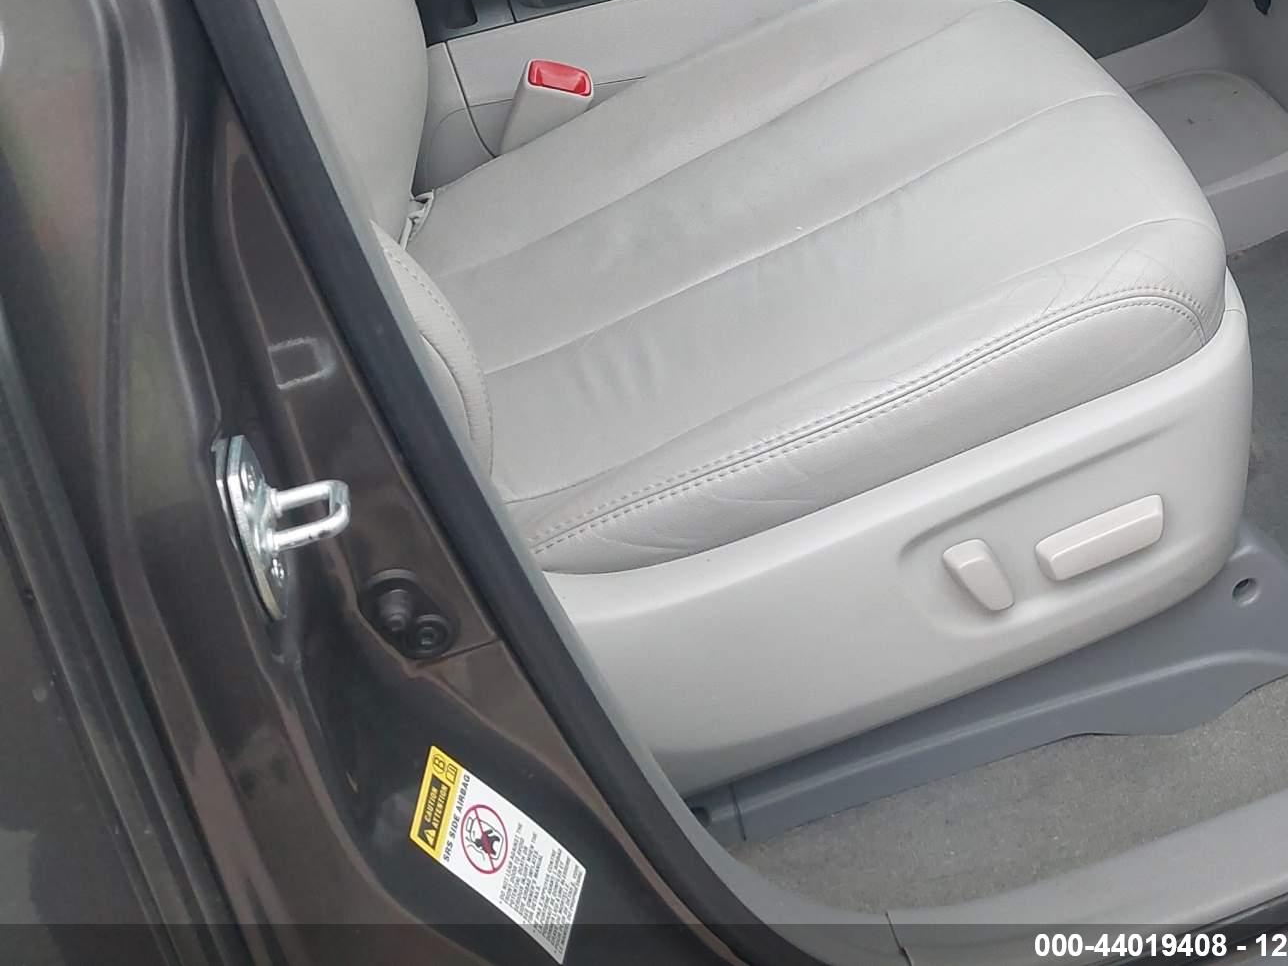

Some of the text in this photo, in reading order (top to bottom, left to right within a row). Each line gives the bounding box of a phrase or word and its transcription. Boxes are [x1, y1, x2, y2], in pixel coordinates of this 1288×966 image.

[423, 785, 438, 823] CAUTION
[431, 782, 448, 830] ATTENTION
[442, 772, 470, 863] SRS SIDE AIRBAG
